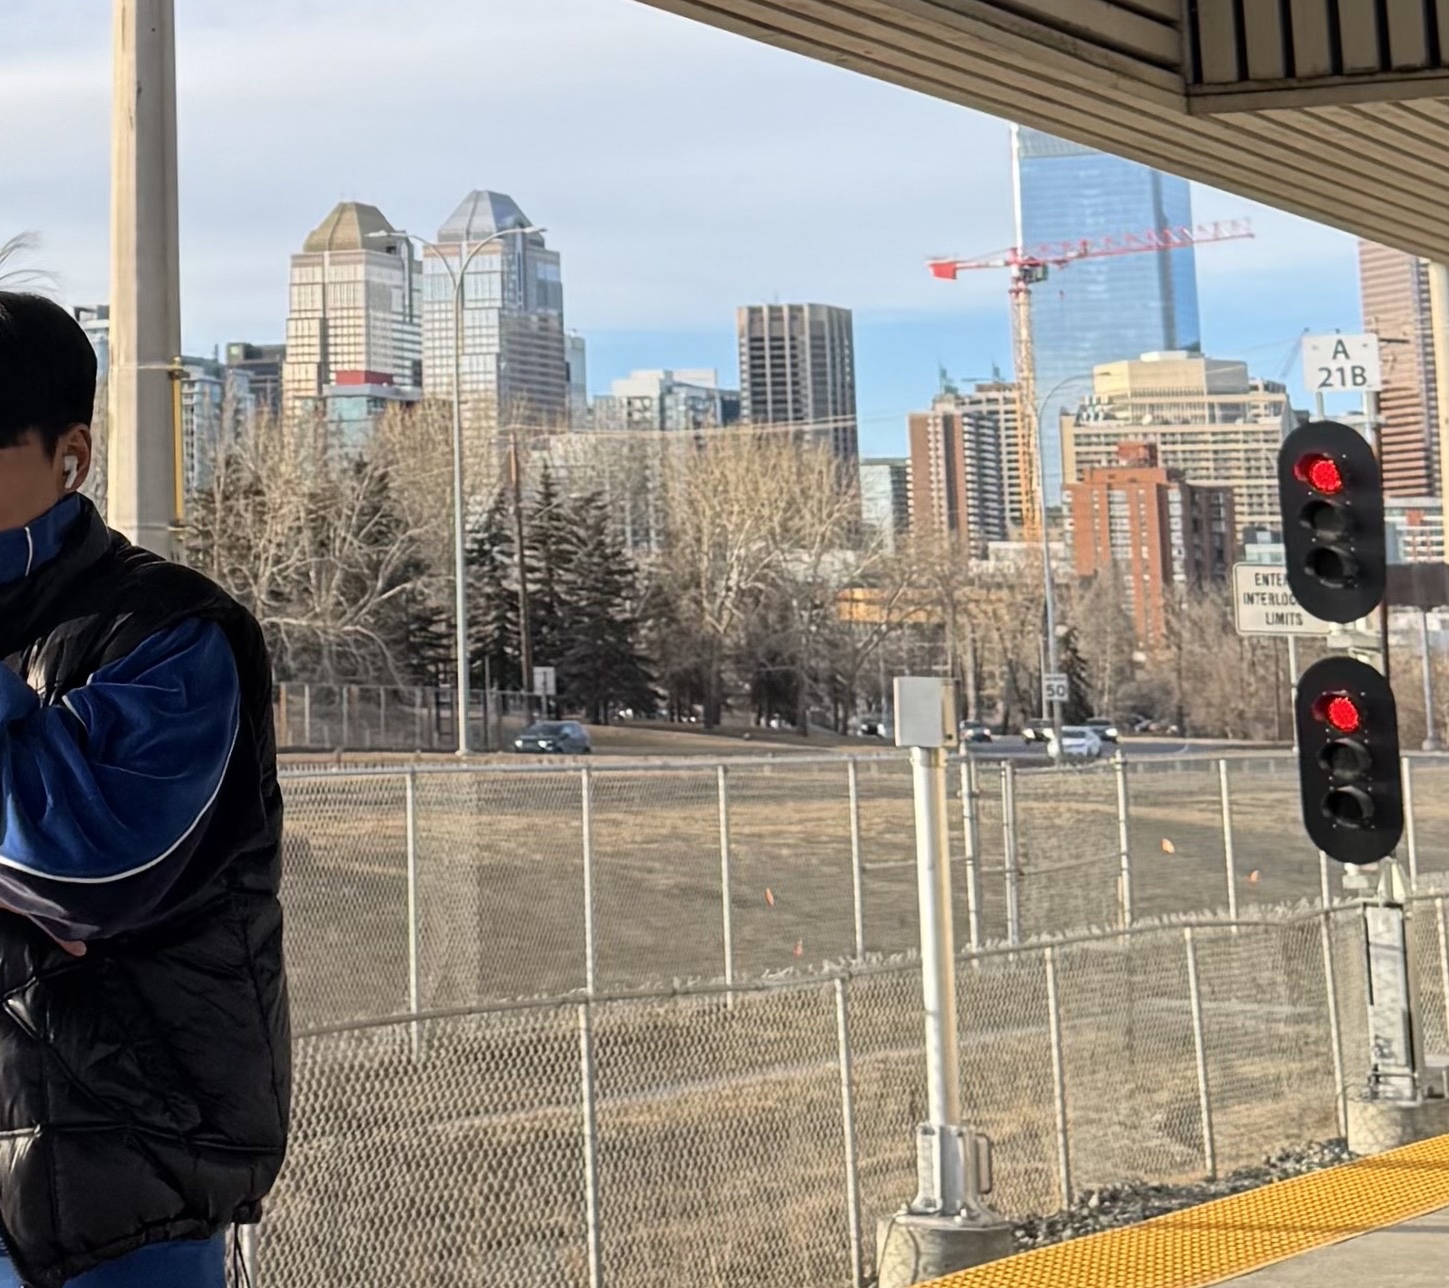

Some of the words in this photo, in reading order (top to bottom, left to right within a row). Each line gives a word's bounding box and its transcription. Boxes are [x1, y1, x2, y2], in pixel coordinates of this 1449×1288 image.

[1332, 338, 1350, 360] A
[1317, 365, 1367, 389] 21B
[1265, 612, 1303, 626] LIMITS
[1046, 683, 1066, 698] 50
